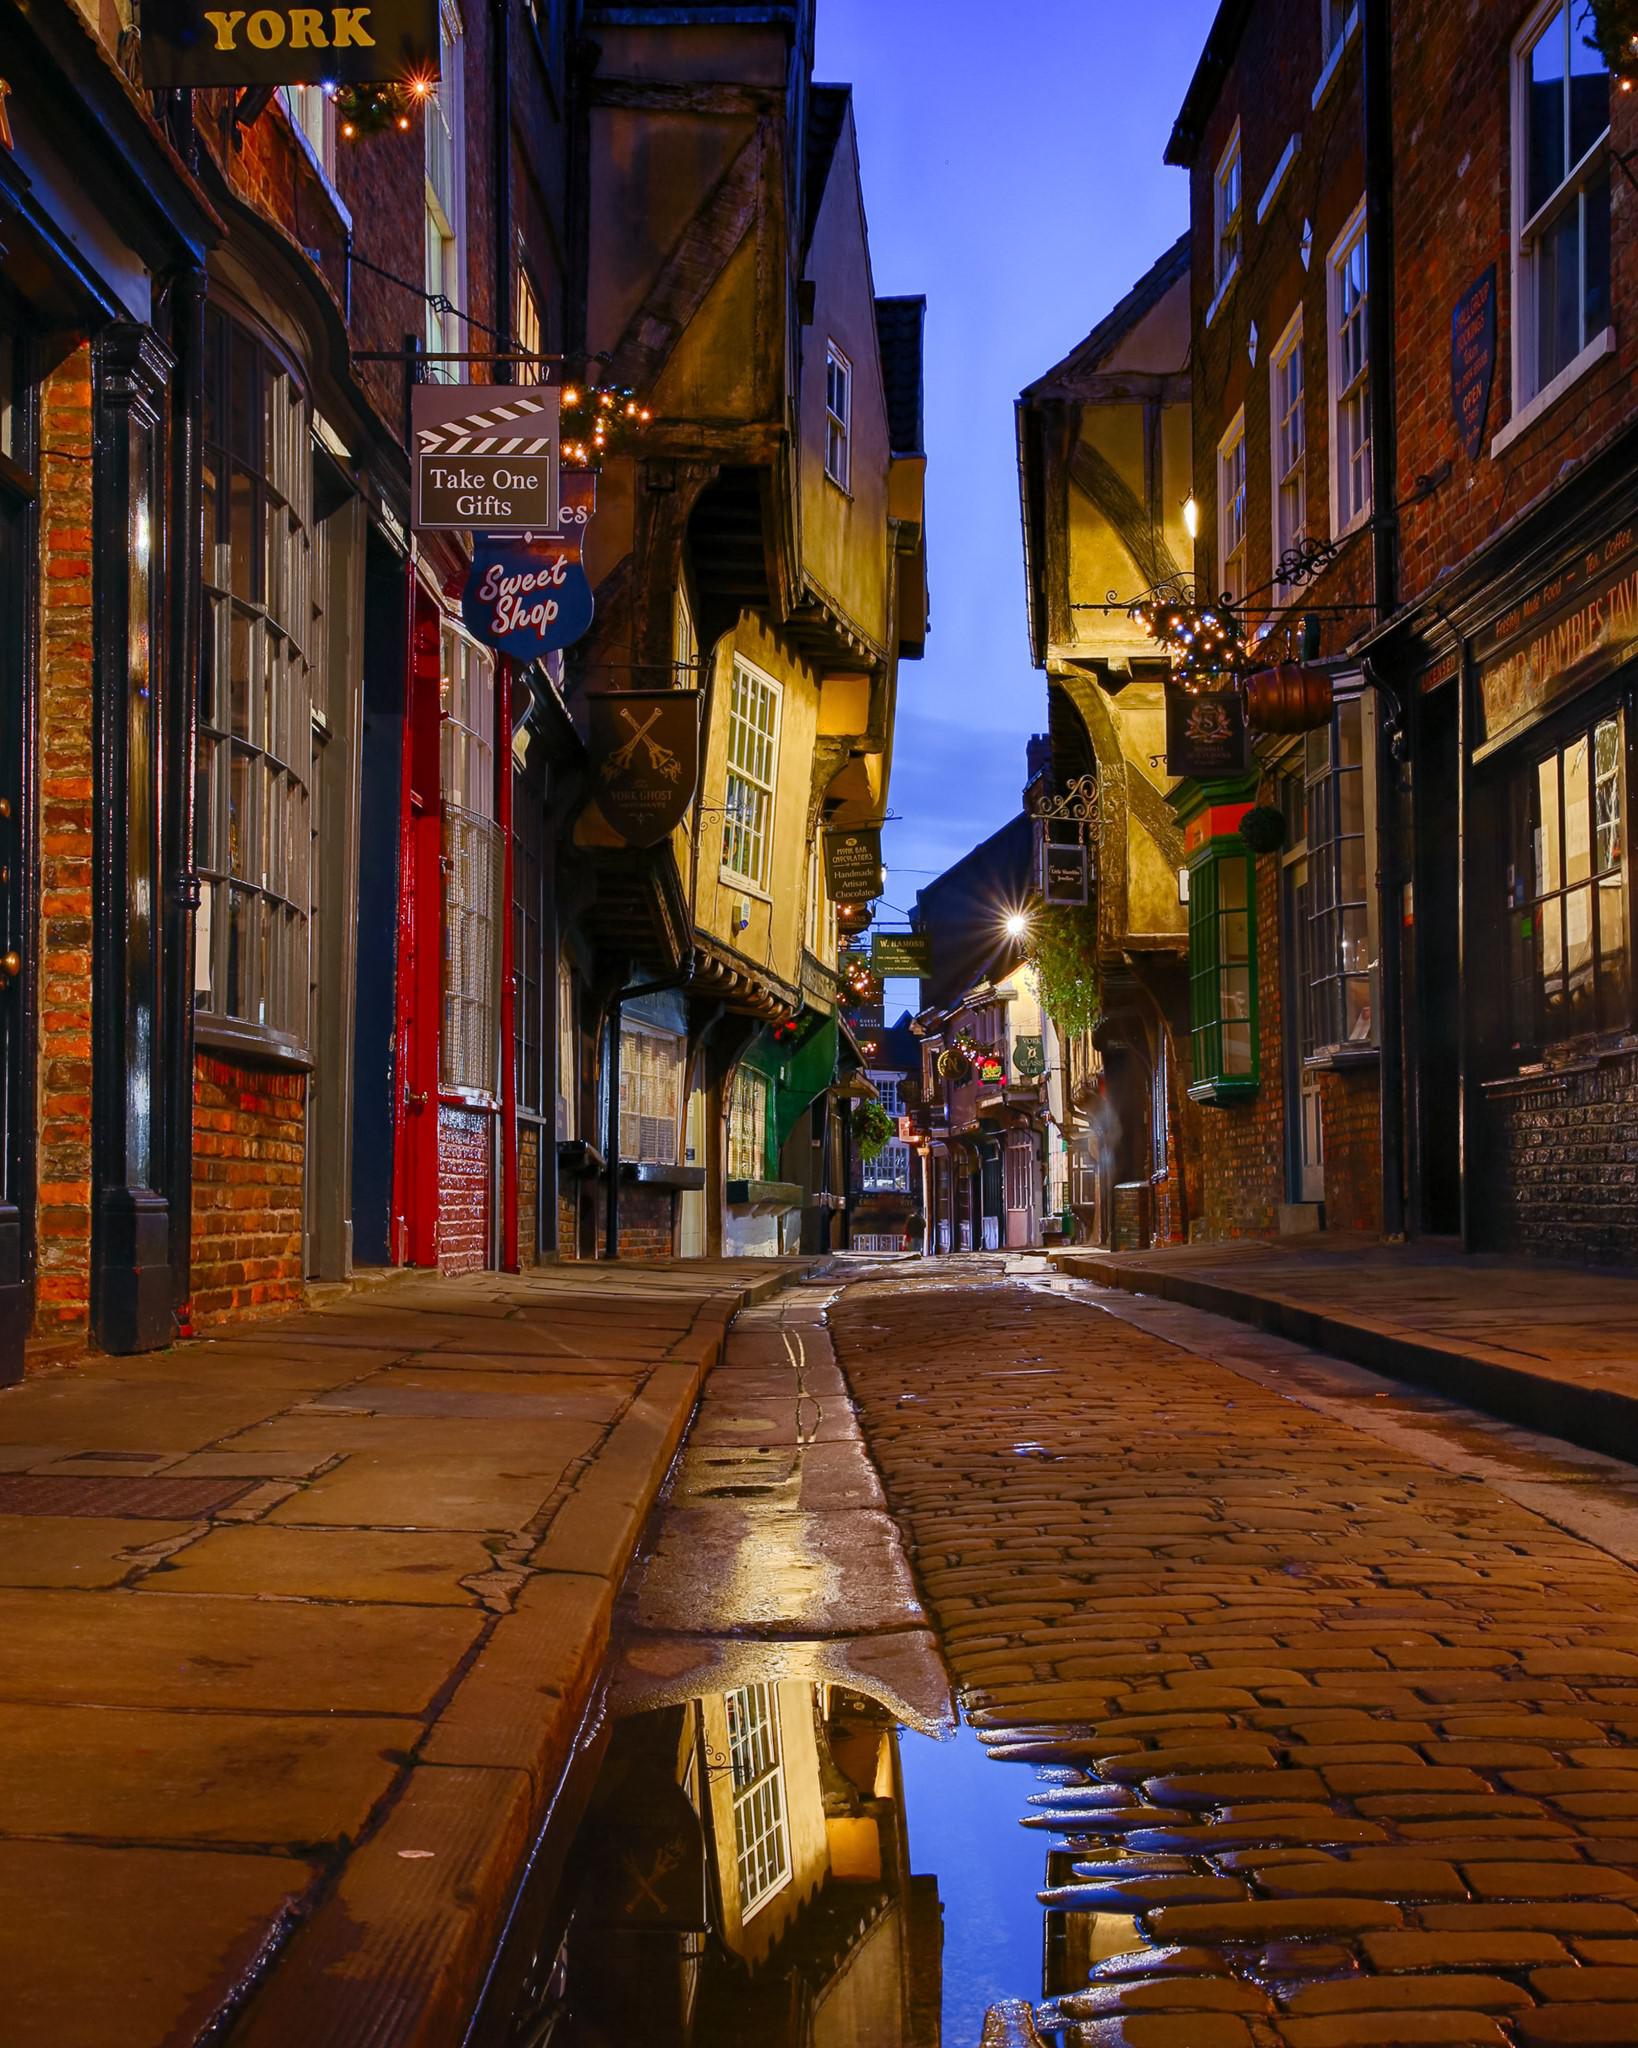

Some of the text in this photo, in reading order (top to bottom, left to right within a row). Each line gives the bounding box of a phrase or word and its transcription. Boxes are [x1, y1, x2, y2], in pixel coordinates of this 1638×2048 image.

[203, 7, 376, 51] YORK
[1463, 380, 1482, 412] OPEN
[430, 469, 539, 489] Take One
[456, 495, 512, 516] Gifts
[479, 554, 568, 601] Sweet
[1543, 575, 1562, 604] Food
[491, 595, 559, 636] Shop
[1530, 597, 1605, 690] SHAMBLES
[610, 790, 672, 801] YORK GHOST
[855, 846, 867, 854] BAR
[834, 868, 874, 879] Handmade
[835, 890, 876, 899] Chocolates
[1022, 1037, 1041, 1045] YORK
